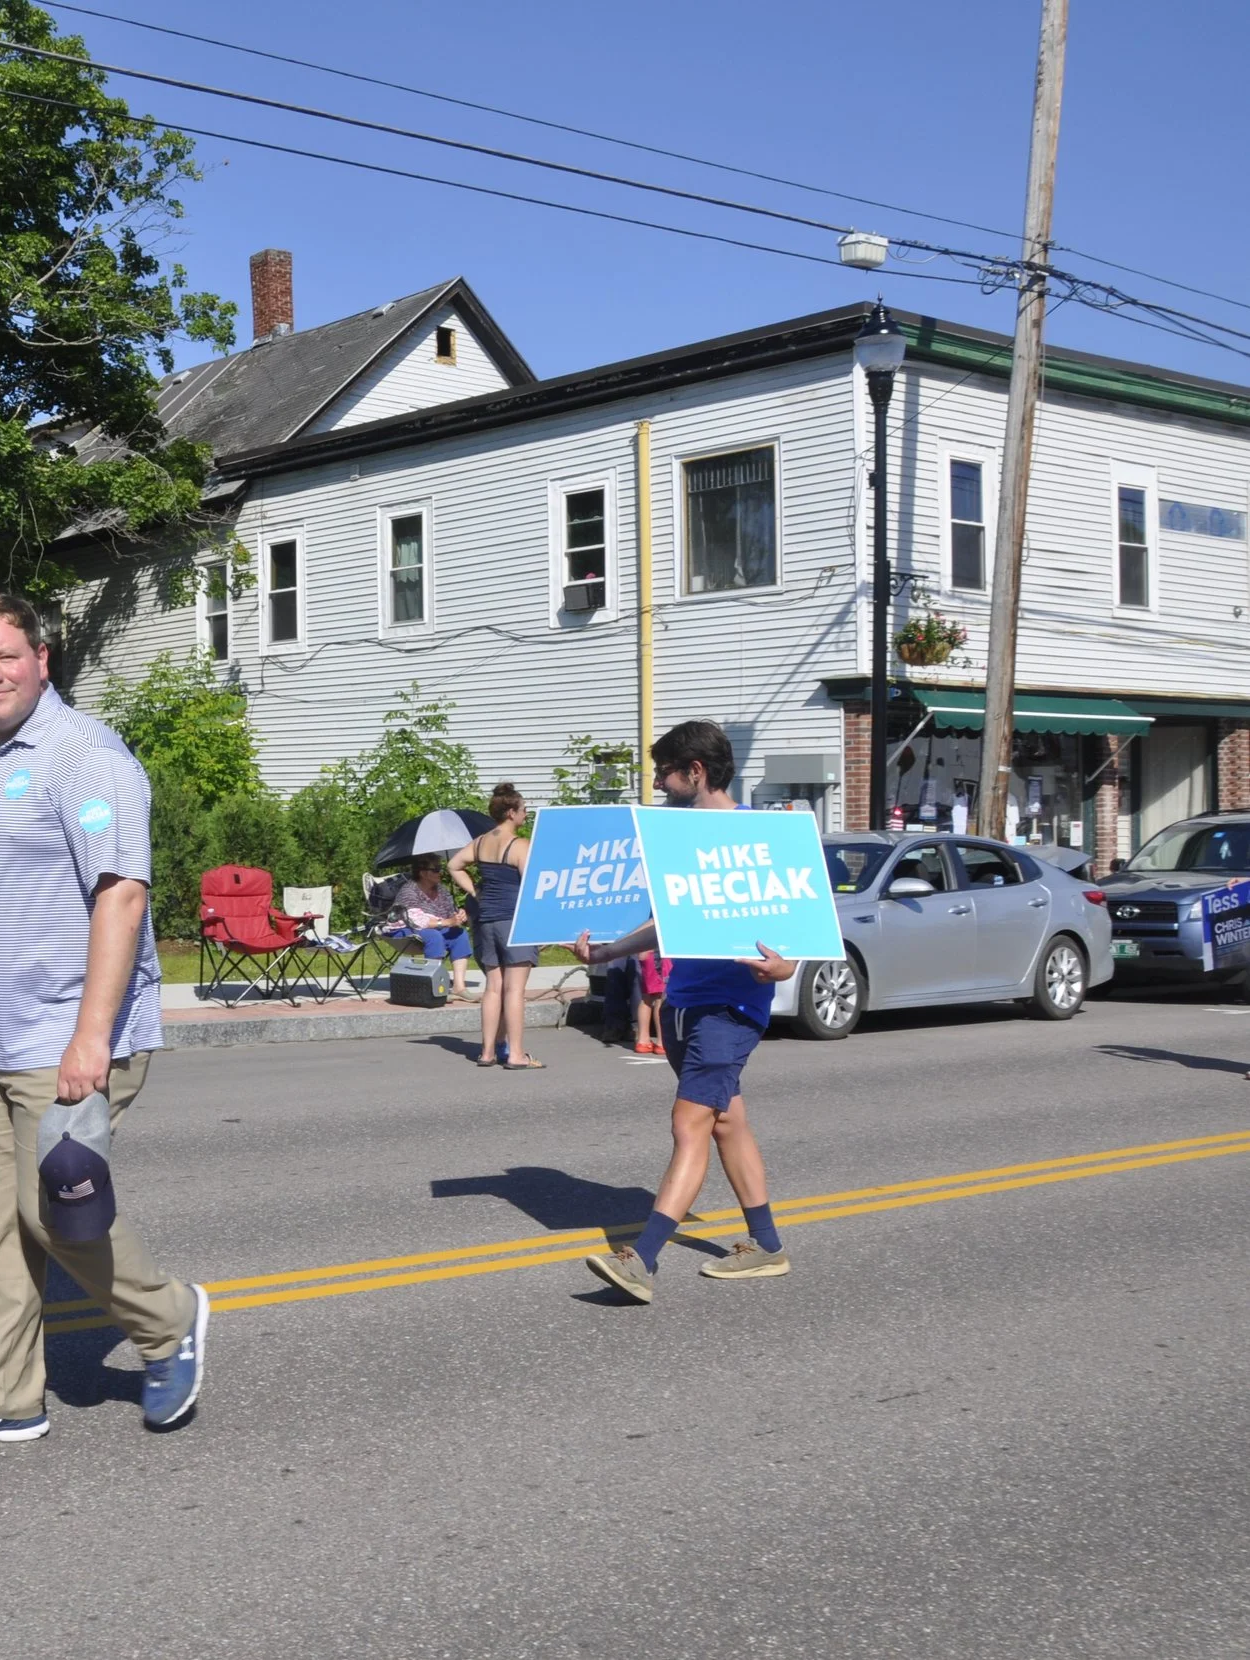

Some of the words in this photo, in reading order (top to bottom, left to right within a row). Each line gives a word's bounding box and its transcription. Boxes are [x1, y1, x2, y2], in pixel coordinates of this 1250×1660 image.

[695, 842, 773, 870] MIKE
[534, 861, 648, 900] PIECIA
[663, 867, 819, 906] PIECIAK
[560, 893, 642, 910] TREASURER
[702, 903, 790, 920] TREASURER
[1204, 893, 1240, 914] Tess
[1214, 917, 1243, 934] CHRIS
